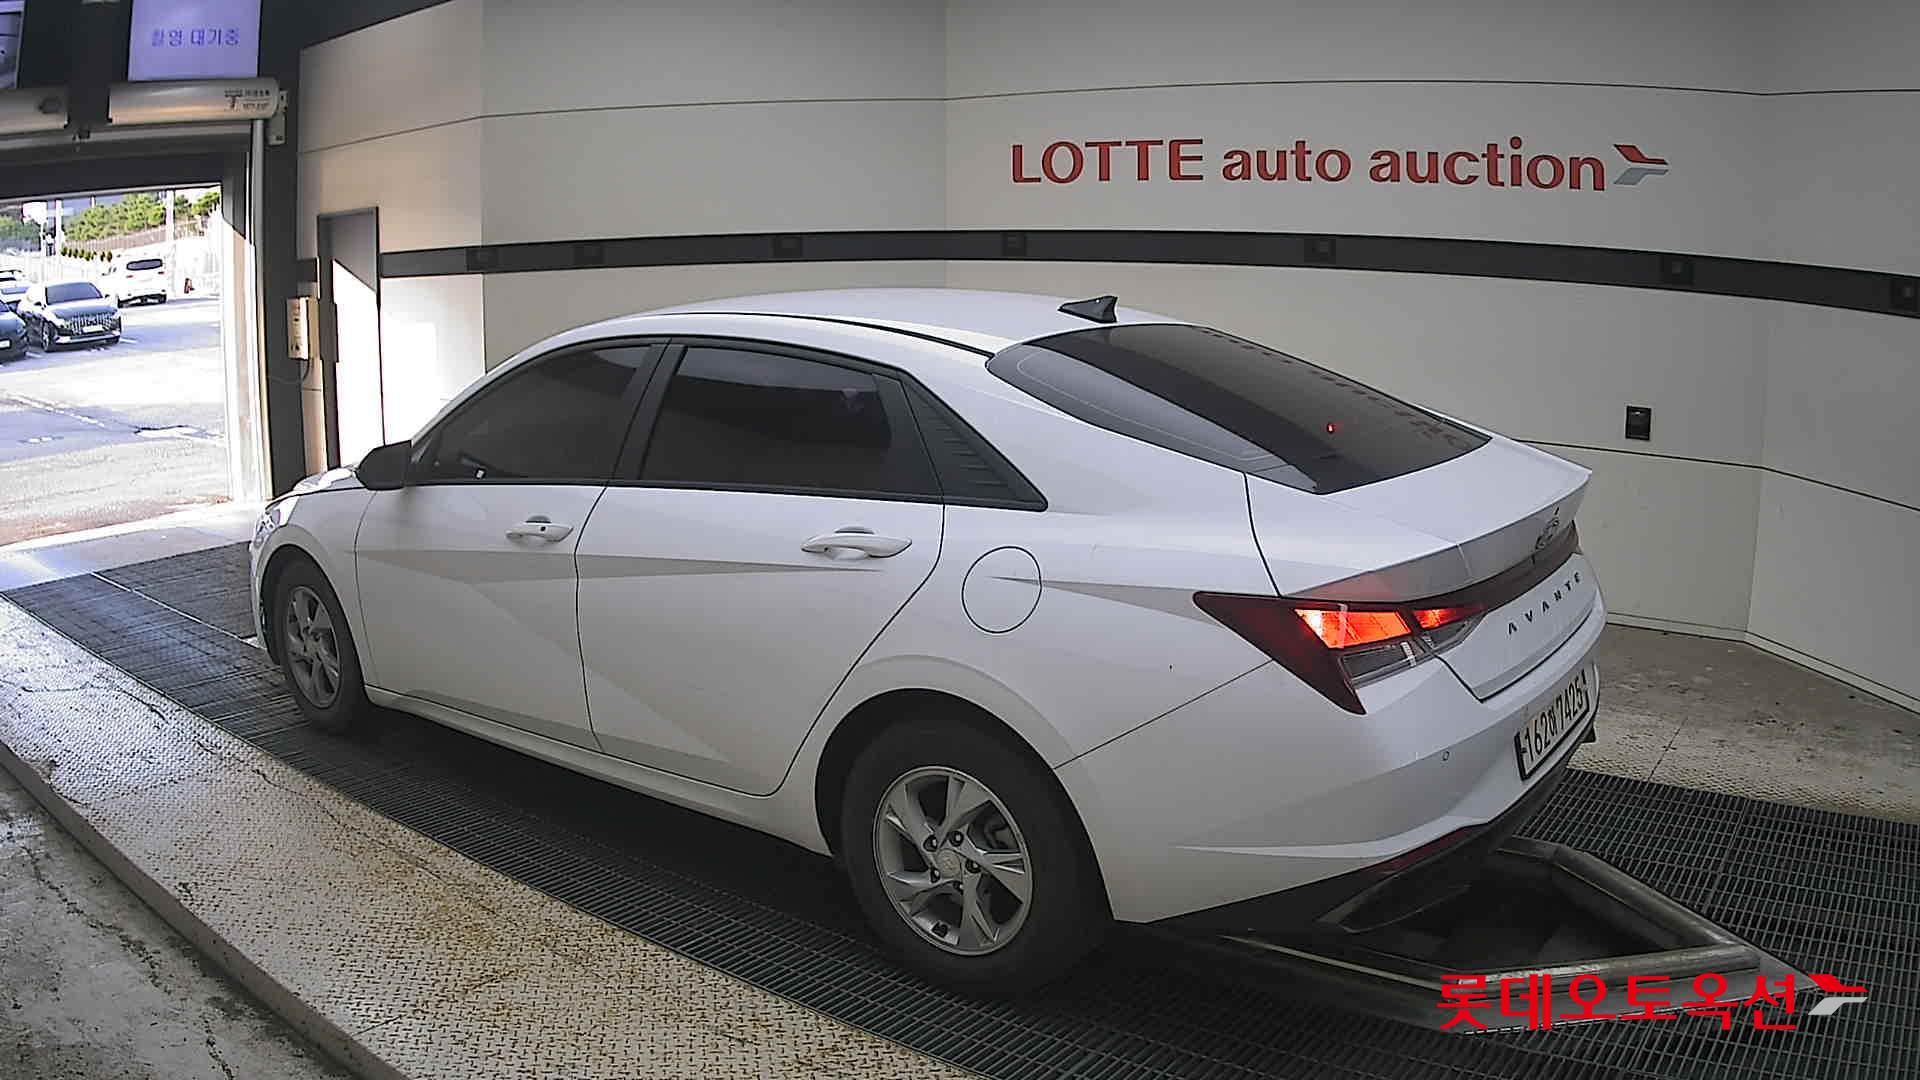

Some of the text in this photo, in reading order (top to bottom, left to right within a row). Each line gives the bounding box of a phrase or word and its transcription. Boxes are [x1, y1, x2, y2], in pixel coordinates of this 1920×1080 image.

[1012, 136, 1606, 192] LOTTE auto auction
[1507, 571, 1580, 635] AVANTE
